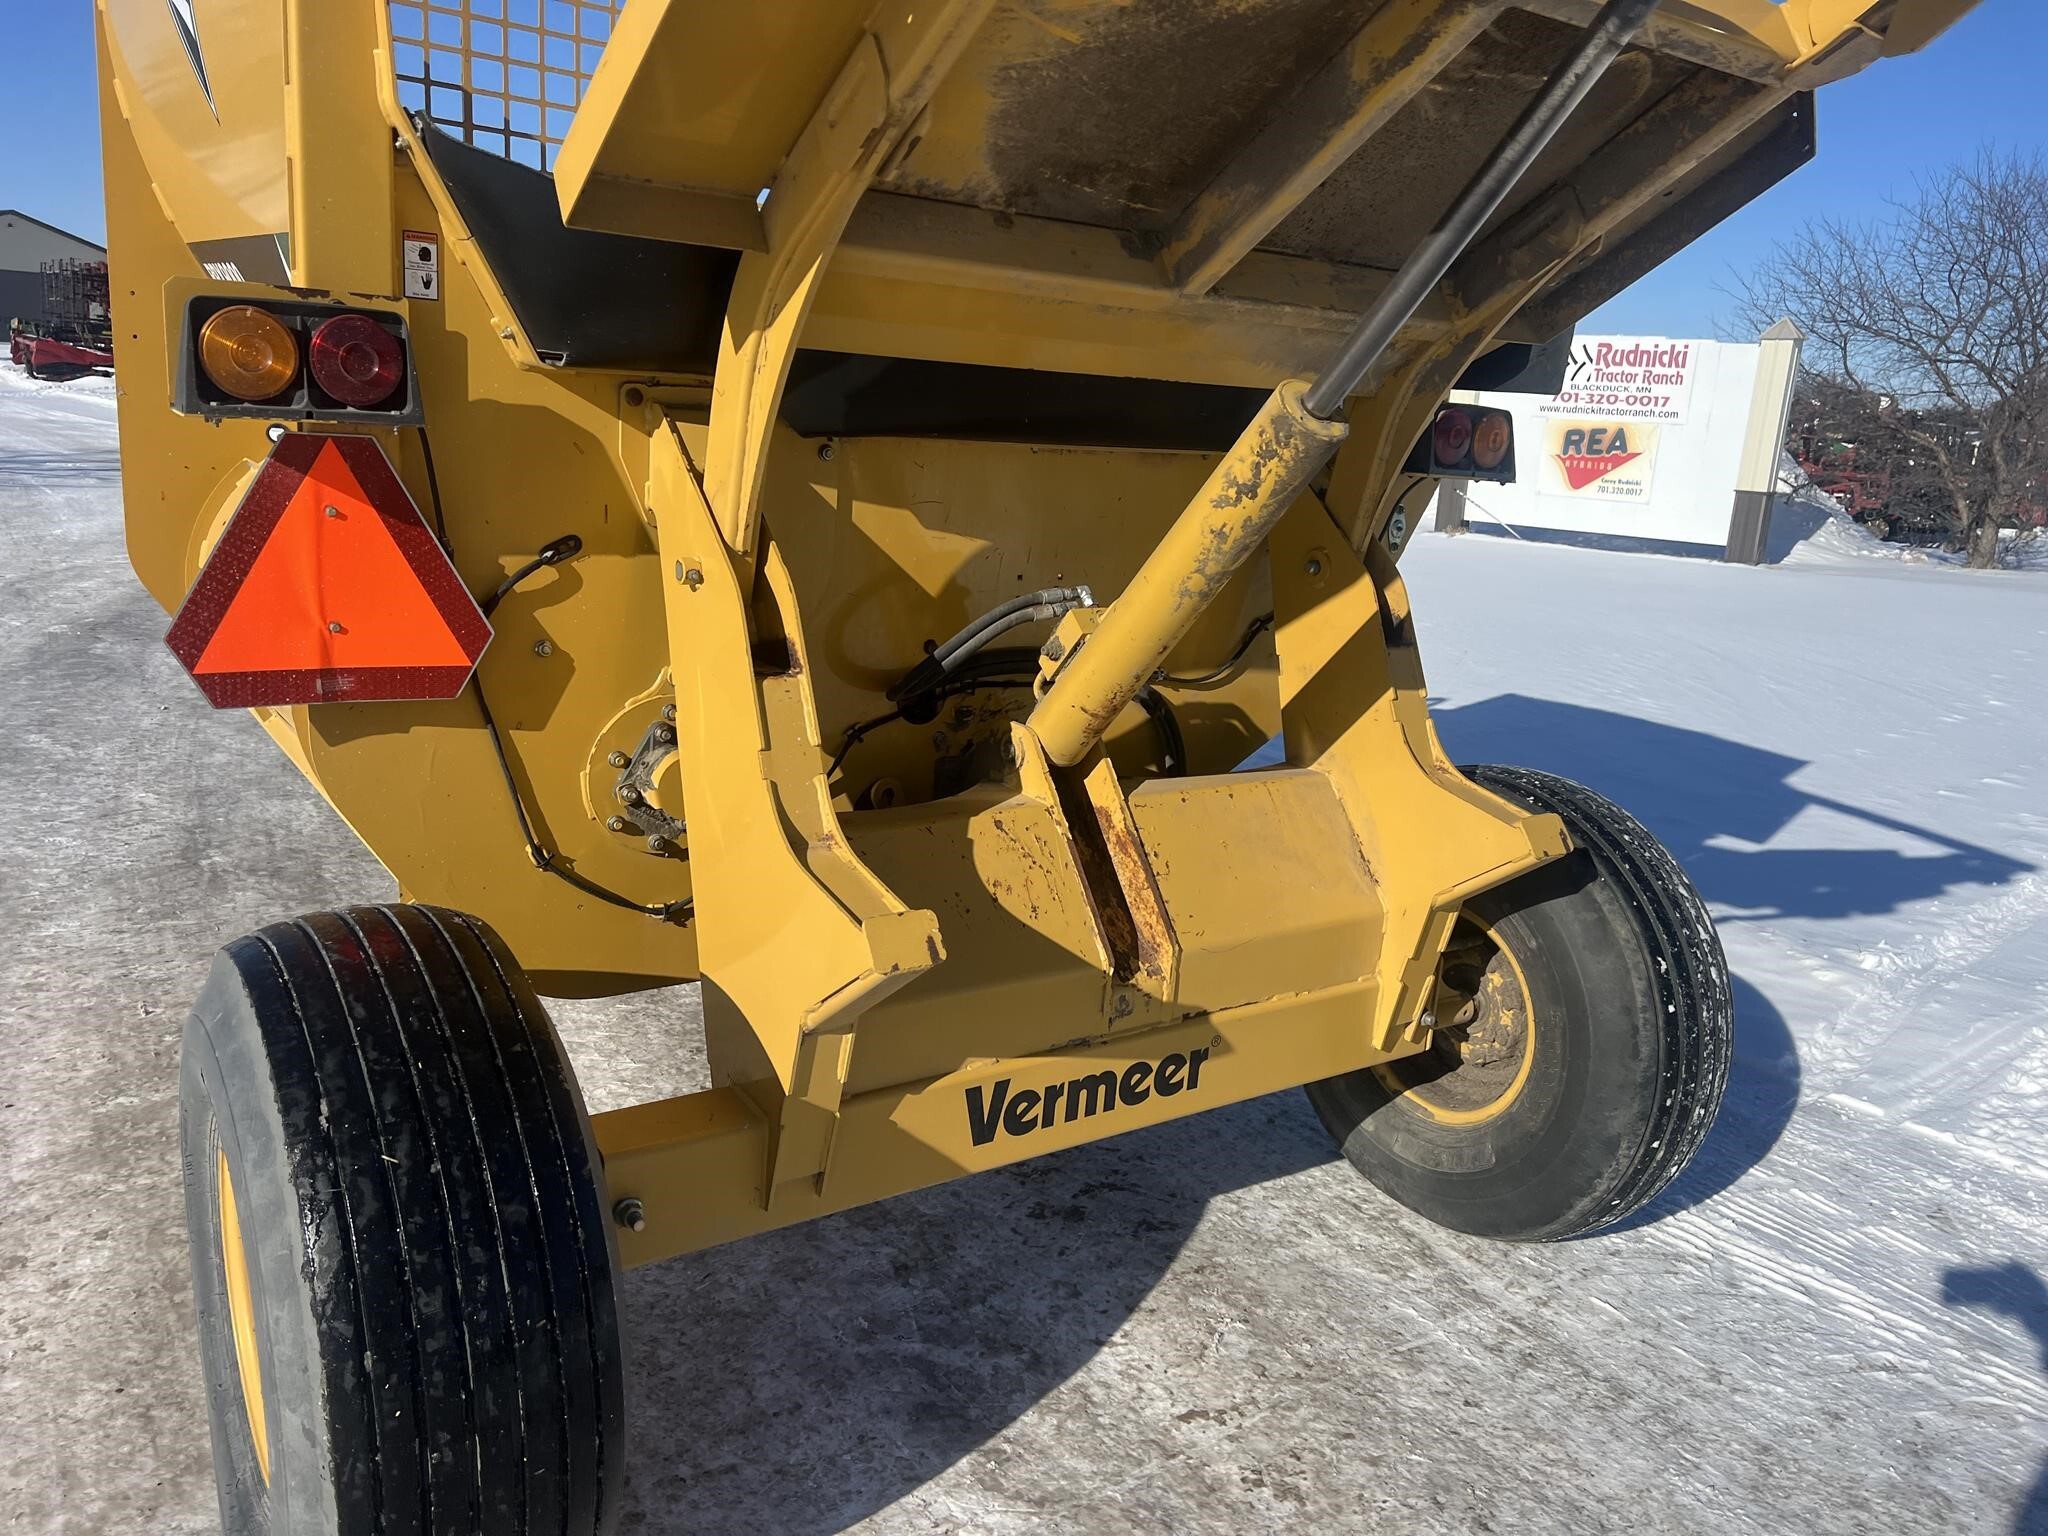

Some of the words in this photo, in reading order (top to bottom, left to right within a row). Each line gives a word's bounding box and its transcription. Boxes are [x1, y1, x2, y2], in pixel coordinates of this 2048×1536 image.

[1595, 342, 1689, 368] Rudnicki
[1594, 368, 1639, 384] Tractor
[1642, 369, 1685, 386] Ranch
[1570, 384, 1632, 393] BLACKDUCK,
[1636, 386, 1652, 394] MN
[1539, 405, 1679, 419] www.rudnickitractorranch.com
[1562, 427, 1628, 456] REA
[1597, 486, 1643, 497] 701.320.0017
[964, 1047, 1210, 1147] Vermeer
